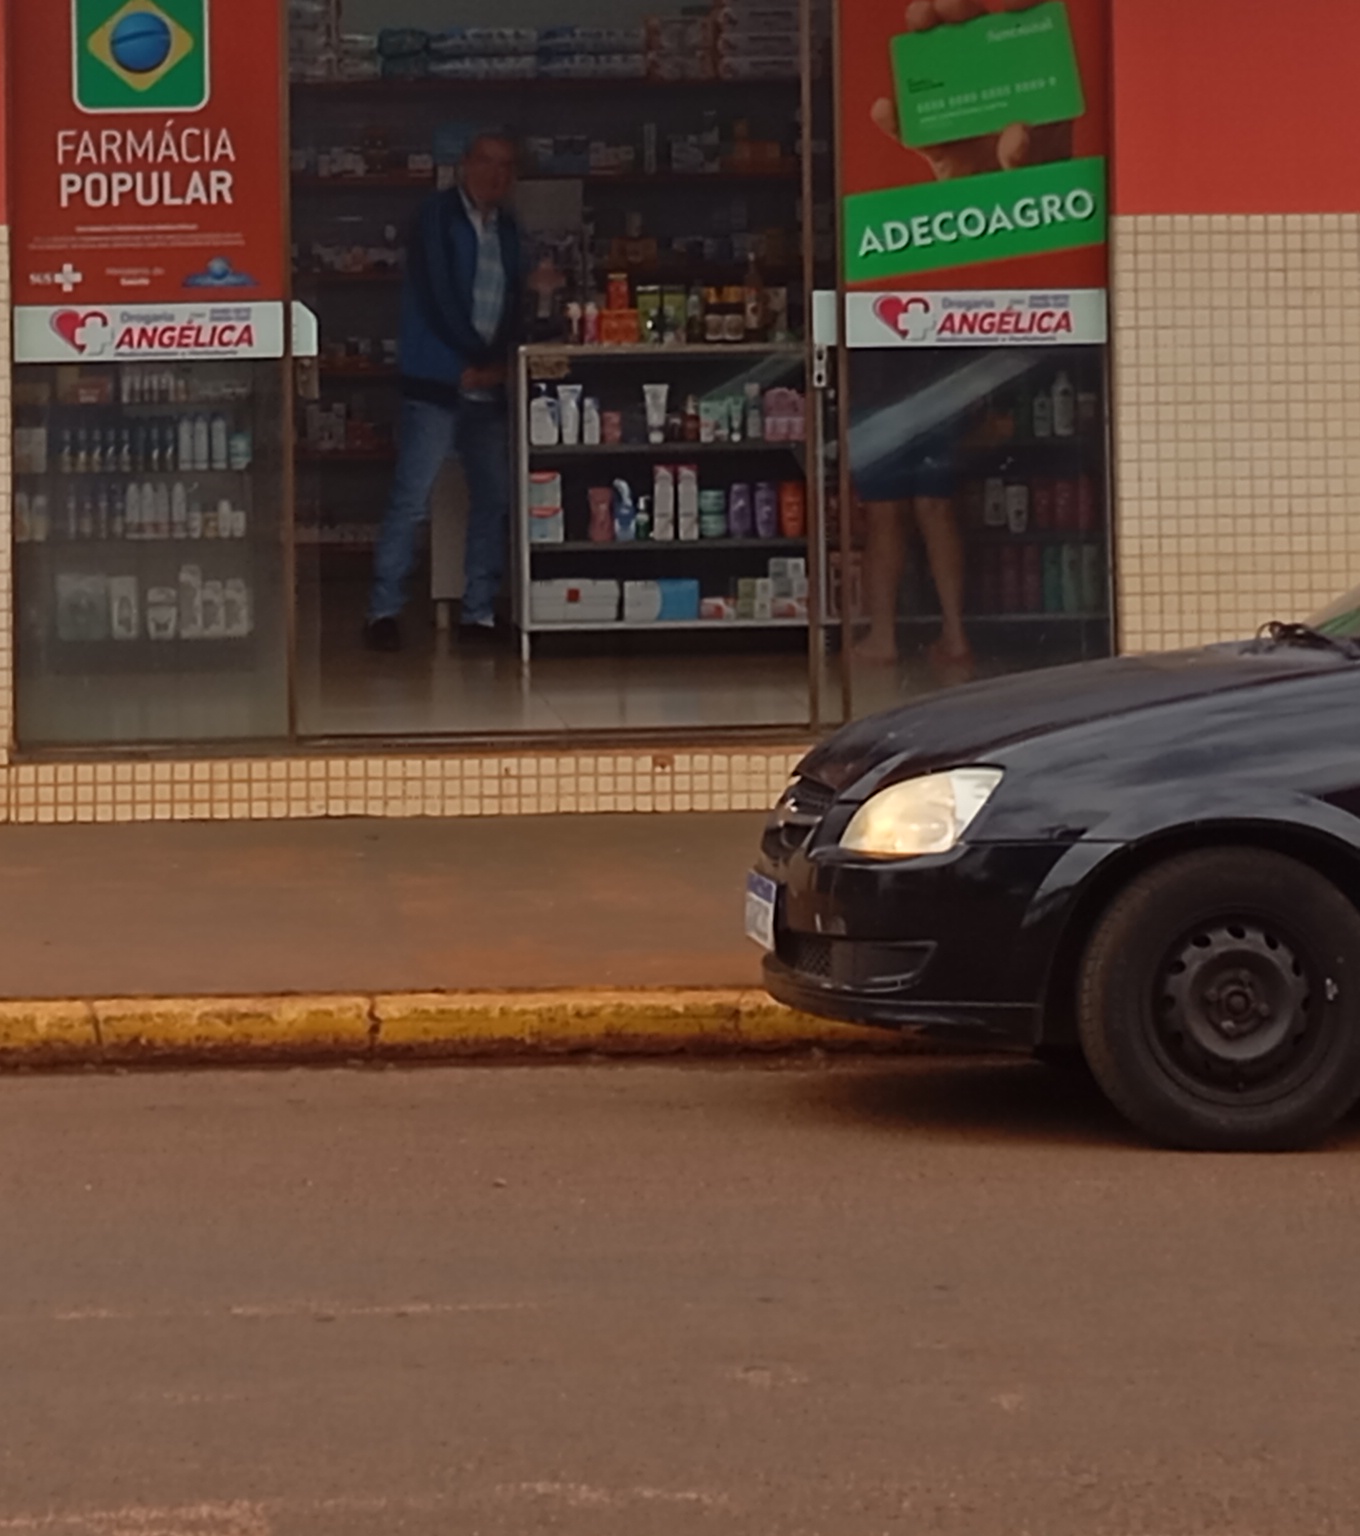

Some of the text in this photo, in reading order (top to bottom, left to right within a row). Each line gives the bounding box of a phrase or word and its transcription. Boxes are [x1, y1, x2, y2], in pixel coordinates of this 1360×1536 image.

[56, 120, 236, 166] FARMÁCIA
[60, 169, 234, 208] POPULAR
[857, 187, 1098, 258] ADECOAGRO
[120, 311, 175, 324] Drogaria
[936, 305, 1072, 335] ANGÉLICA
[941, 297, 995, 310] Drogaria
[114, 317, 254, 350] ANGÉLICA
